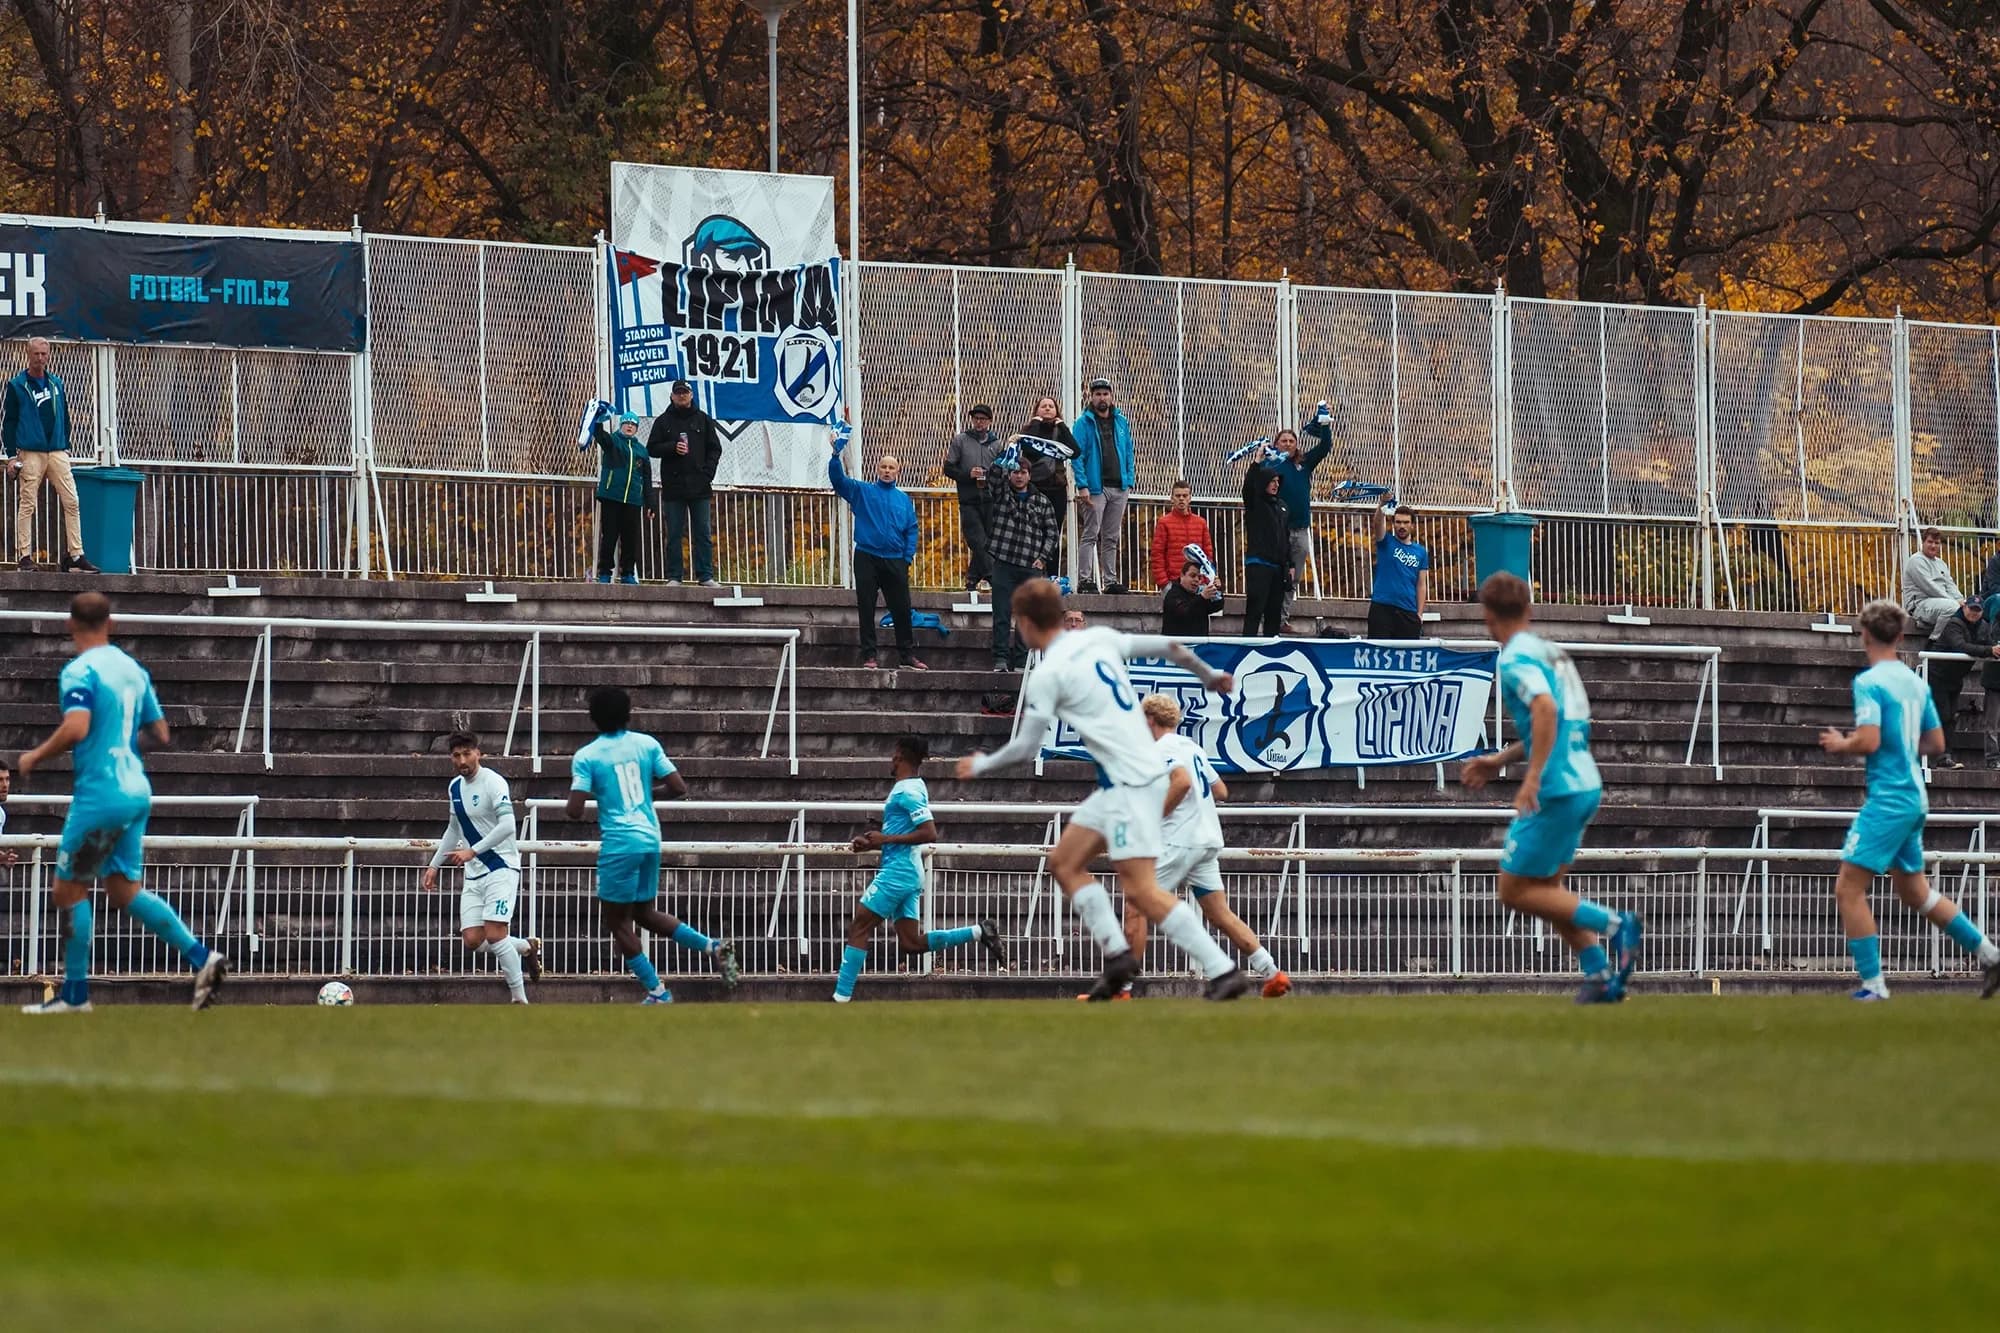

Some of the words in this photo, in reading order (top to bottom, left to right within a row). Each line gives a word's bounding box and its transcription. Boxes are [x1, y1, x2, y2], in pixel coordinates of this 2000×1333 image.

[130, 274, 290, 307] FOTBAL-FM.CZ
[662, 262, 839, 336] LIPINA
[625, 328, 664, 342] STADION
[682, 333, 758, 379] 1921
[632, 368, 667, 383] PLECHU
[1094, 660, 1134, 712] 8
[1355, 678, 1463, 759] LIPINA
[614, 761, 645, 811] 18
